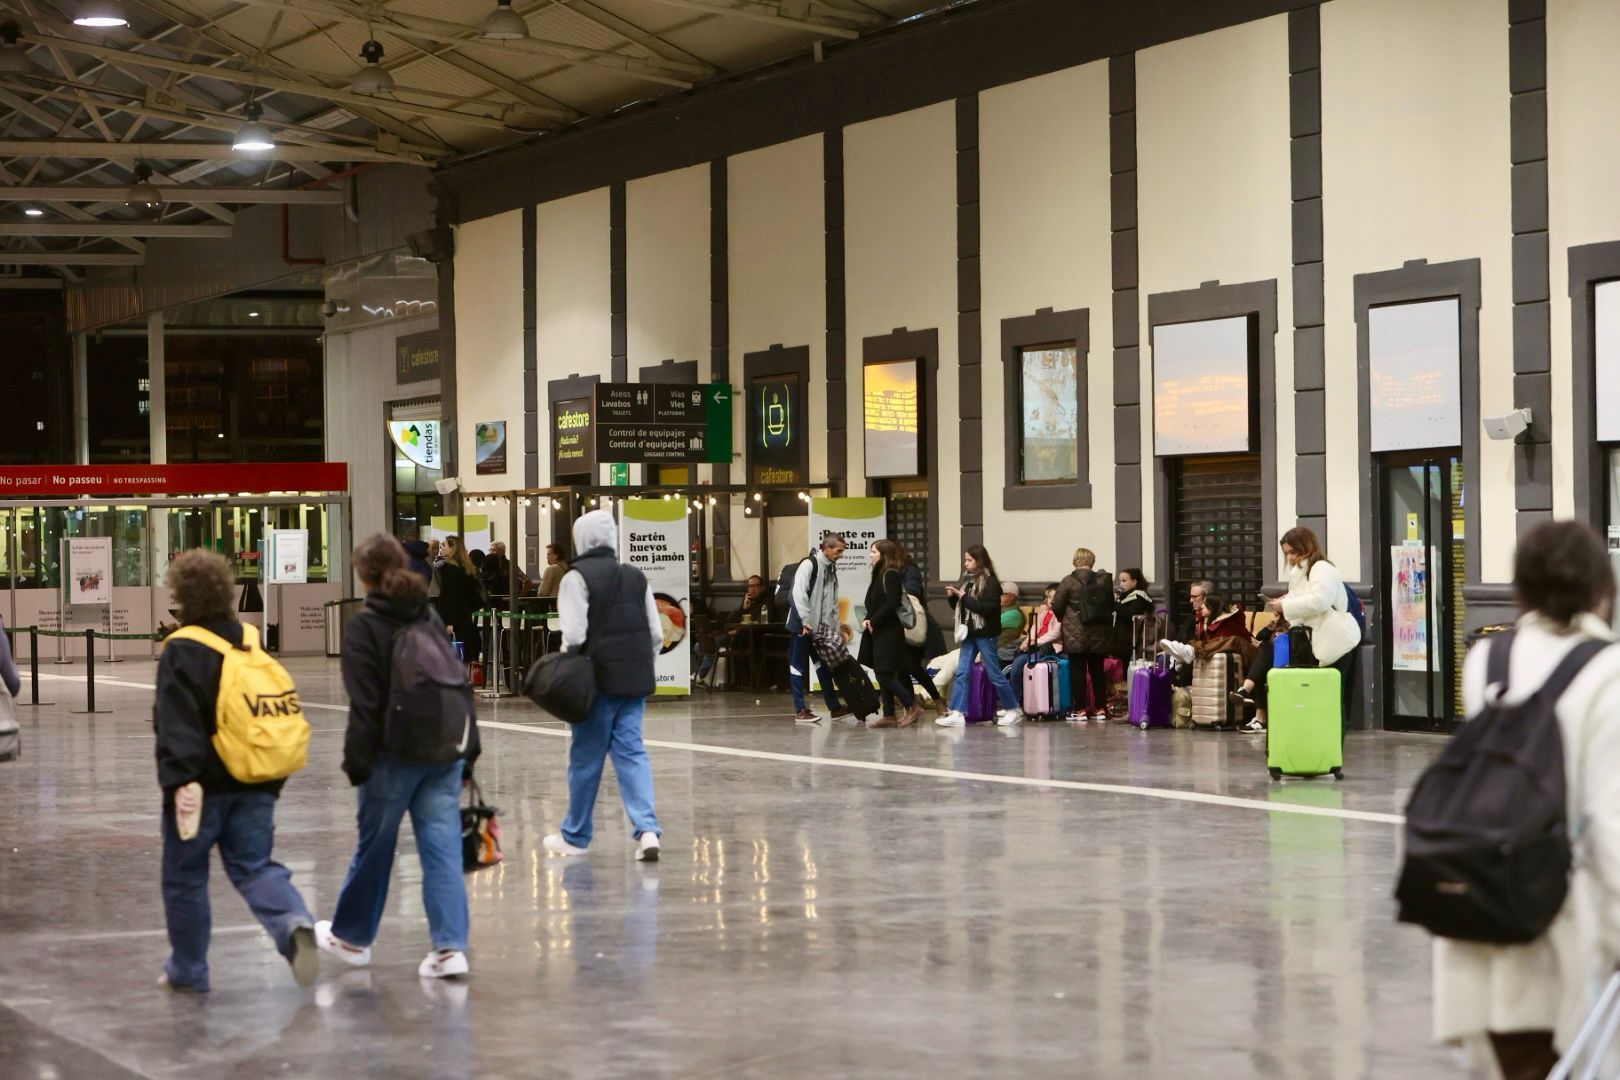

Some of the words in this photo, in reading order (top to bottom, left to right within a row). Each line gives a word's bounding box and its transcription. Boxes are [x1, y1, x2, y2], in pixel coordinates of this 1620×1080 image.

[610, 390, 631, 398] Aseos
[601, 400, 631, 408] Lavabos
[670, 400, 685, 408] Vies
[557, 410, 590, 429] cafestore
[608, 429, 636, 437] Control
[637, 429, 647, 437] de
[649, 429, 686, 438] equipajes
[424, 423, 433, 464] tiendas
[609, 440, 636, 448] Control
[638, 439, 686, 450] d'equipatjes
[0, 476, 12, 485] No
[15, 476, 42, 487] pasar
[52, 475, 66, 485] No
[68, 475, 102, 487] passeu
[760, 467, 794, 484] cafestore
[629, 531, 665, 542] Sartén
[819, 529, 857, 540] ¡Pnte
[630, 543, 667, 552] huevos
[630, 554, 648, 562] con
[651, 551, 685, 564] jamón
[243, 690, 301, 718] VANS
